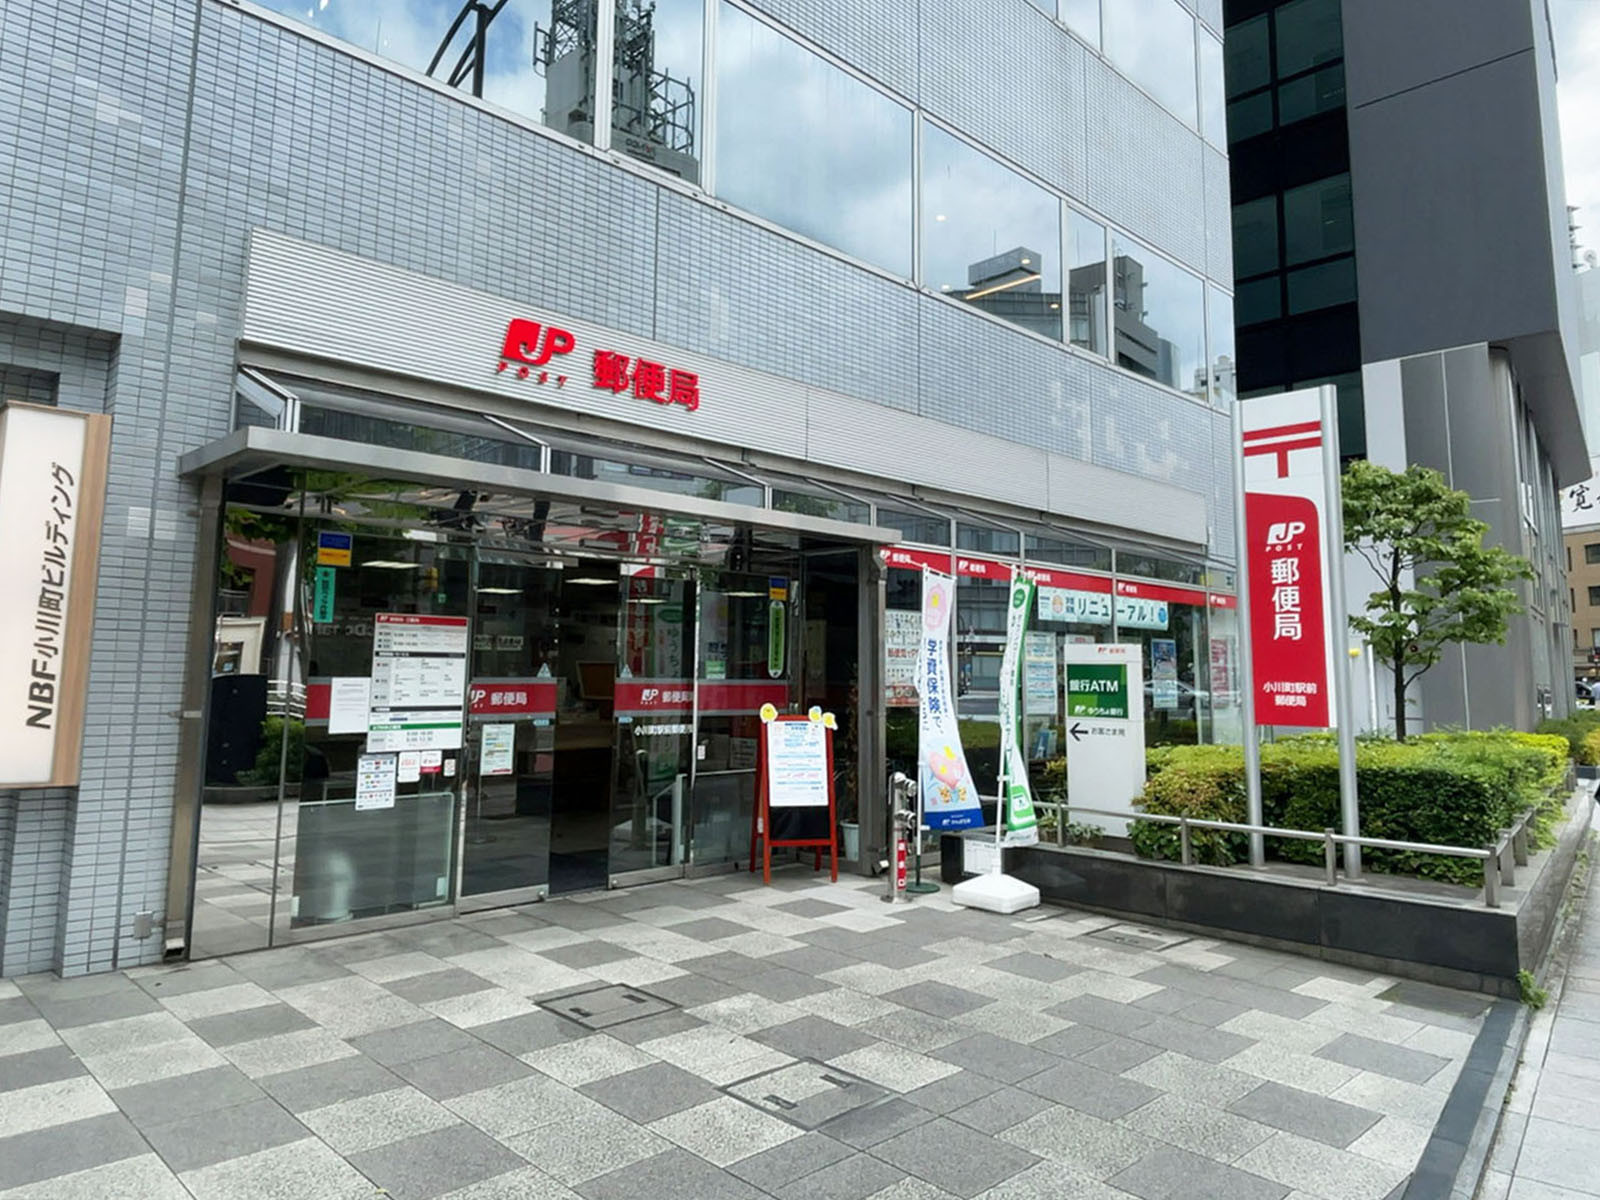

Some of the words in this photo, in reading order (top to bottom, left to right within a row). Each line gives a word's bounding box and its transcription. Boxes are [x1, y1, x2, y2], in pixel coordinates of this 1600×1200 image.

[497, 360, 567, 388] POST
[502, 318, 575, 366] JP
[594, 349, 699, 411] 郵便局
[1267, 521, 1306, 545] JP
[1265, 543, 1304, 552] POST
[25, 461, 75, 730] NBF小川町ビルディング
[1271, 557, 1302, 641] 郵便局
[1069, 679, 1119, 692] 銀行ATM
[1263, 682, 1317, 694] 小川町駅前
[491, 691, 528, 706] 郵便局
[1275, 695, 1307, 707] 郵便局
